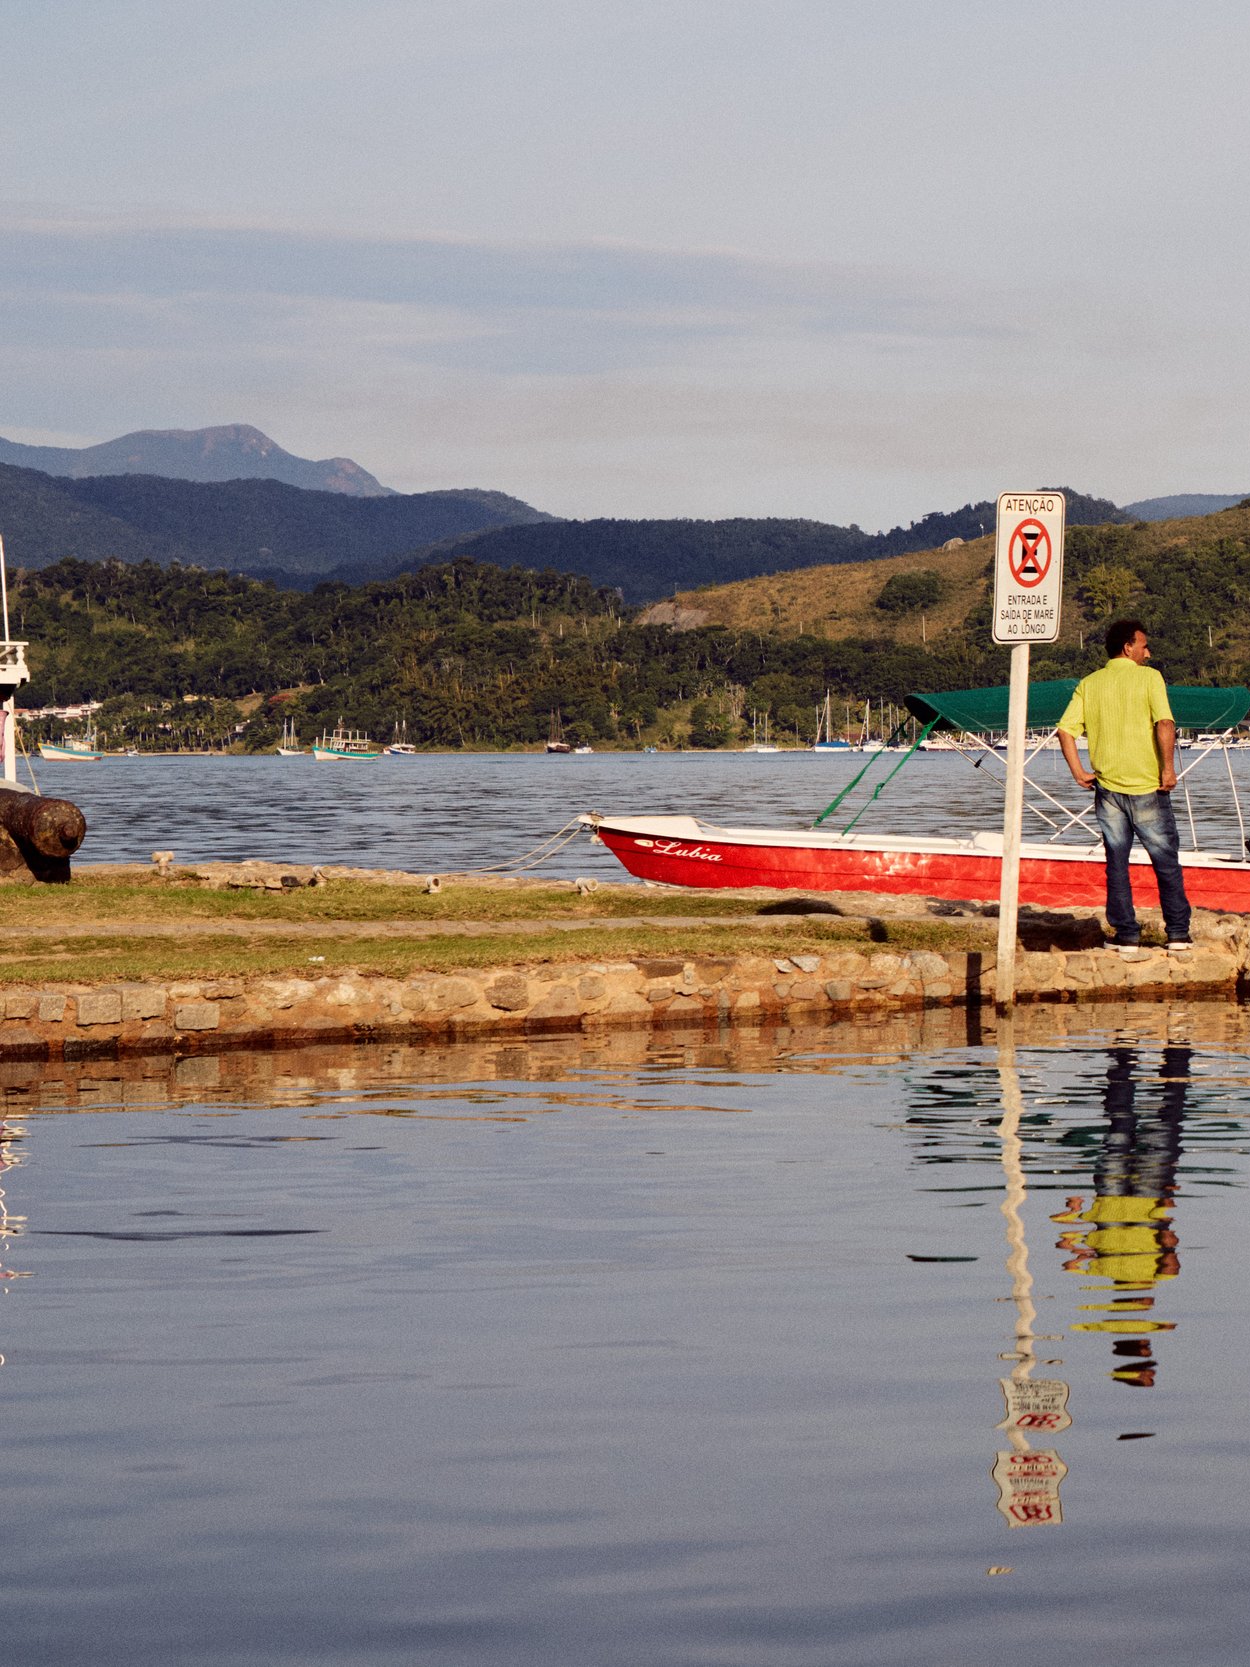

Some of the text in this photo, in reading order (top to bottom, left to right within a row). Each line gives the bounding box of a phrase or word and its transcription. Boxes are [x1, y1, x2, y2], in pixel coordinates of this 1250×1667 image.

[1006, 497, 1054, 515] ATENÇÃO
[1008, 595, 1048, 606] ENTRADA E
[1001, 608, 1021, 620] SAÍDA
[1022, 609, 1032, 620] DE
[1008, 623, 1046, 634] AO LONGO
